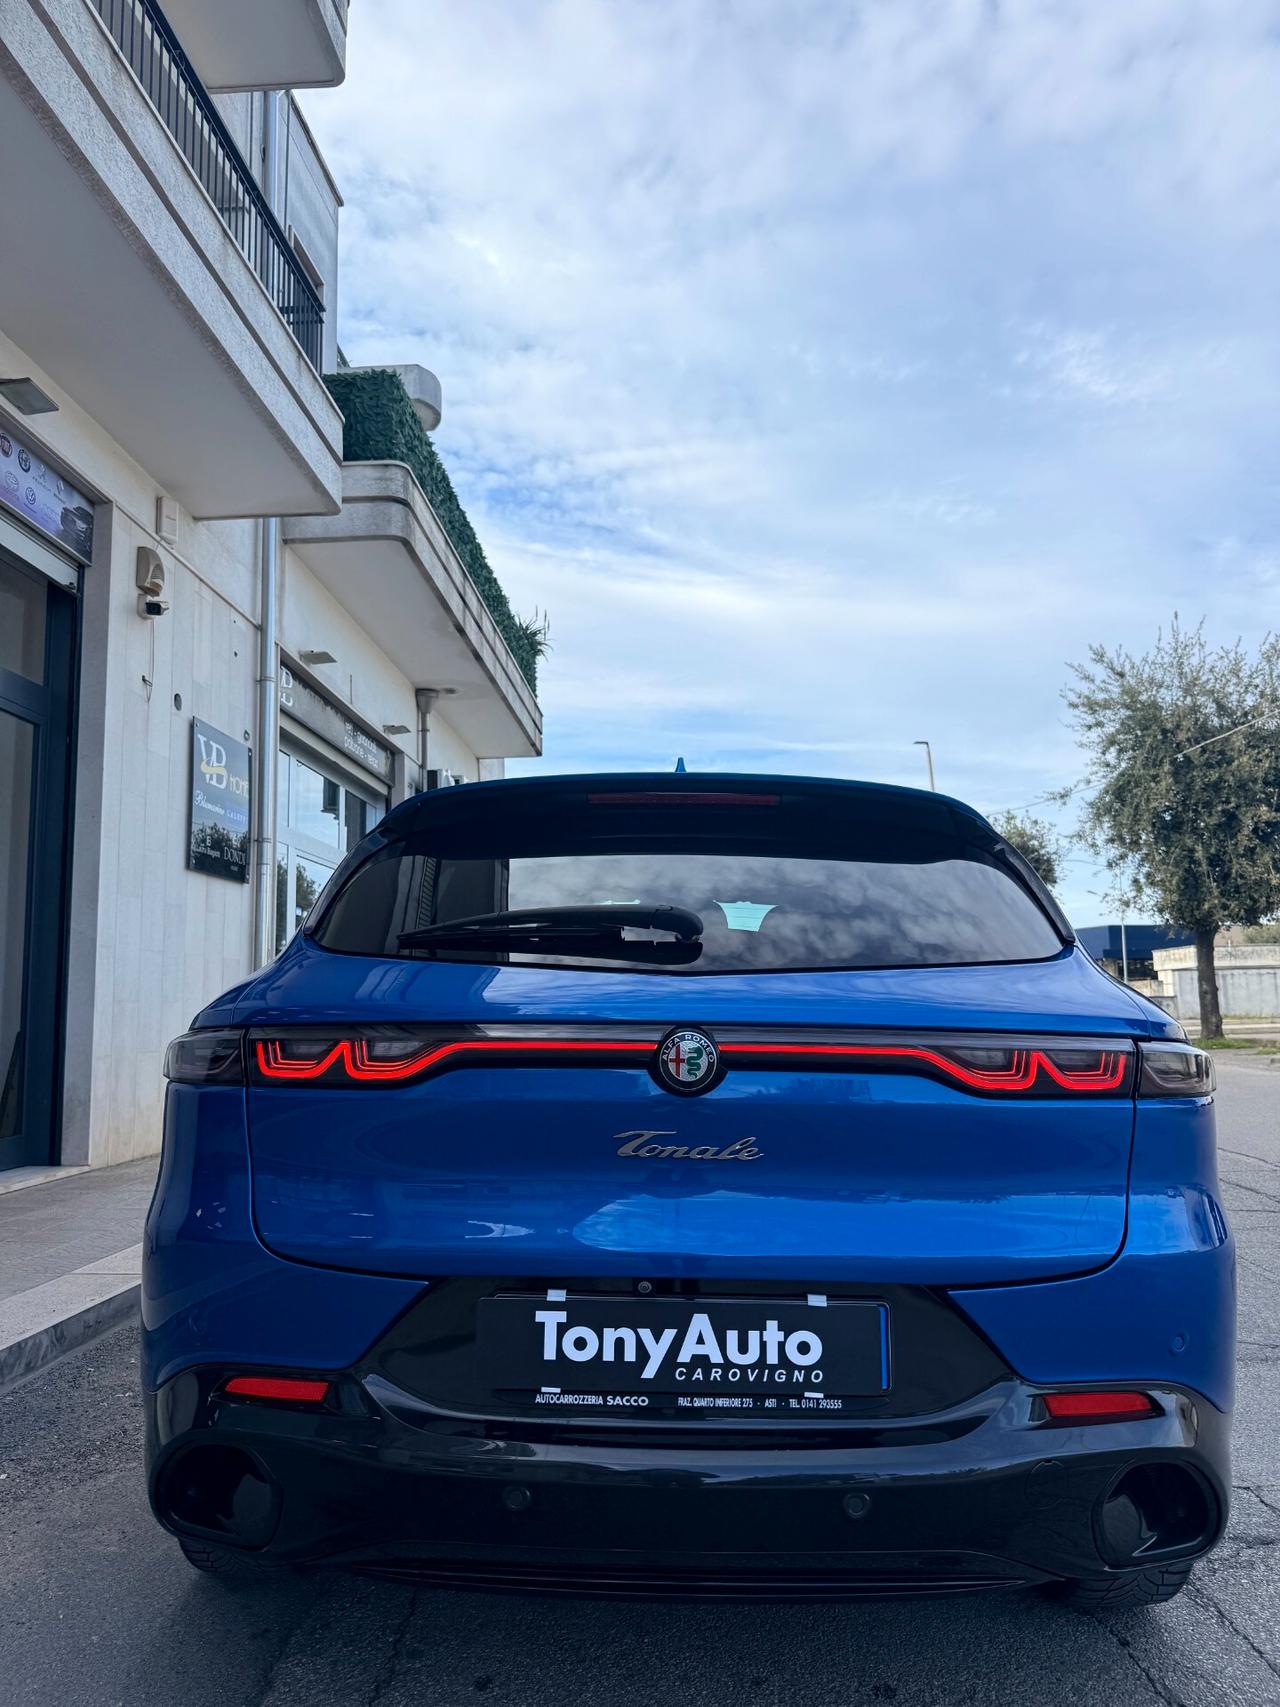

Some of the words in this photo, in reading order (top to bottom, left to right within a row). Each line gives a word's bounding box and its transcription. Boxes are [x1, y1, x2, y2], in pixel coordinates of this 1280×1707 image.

[662, 1037, 680, 1061] ALFA
[685, 1034, 715, 1063] ROMEO
[613, 1130, 764, 1161] Tonale
[675, 1367, 823, 1383] CAROVIGNO
[535, 1394, 604, 1405] AUTOCARROZZERIA
[606, 1395, 649, 1406] SACCO
[692, 1397, 714, 1408] QUARTO
[715, 1397, 741, 1408] INFERIORE
[742, 1397, 753, 1408] 275
[764, 1397, 777, 1408] ASTI
[801, 1398, 818, 1409] 0141
[818, 1398, 843, 1409] 293555
